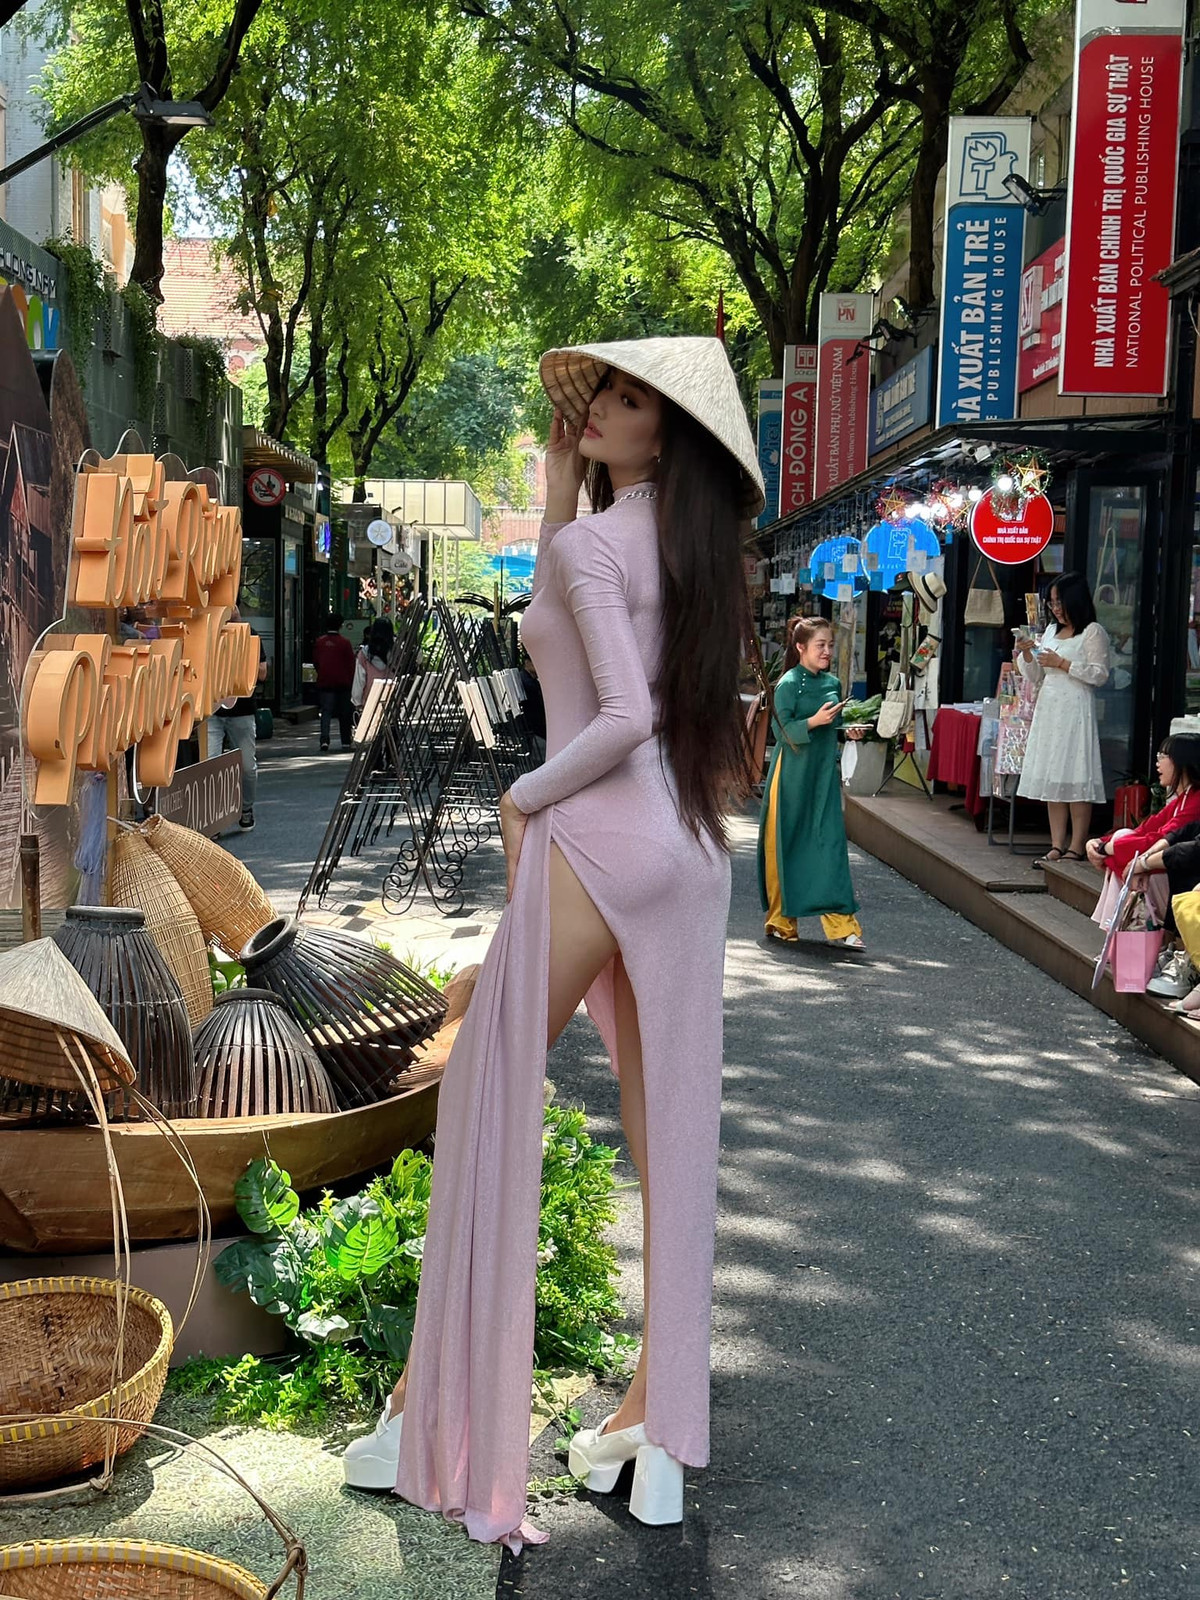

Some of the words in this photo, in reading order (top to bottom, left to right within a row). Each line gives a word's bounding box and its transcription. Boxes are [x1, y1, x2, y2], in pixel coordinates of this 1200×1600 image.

[1105, 54, 1133, 90] THẬT
[1140, 56, 1155, 108] HOUSE
[1106, 92, 1132, 114] SỰ
[1106, 117, 1127, 142] GIA
[1099, 146, 1127, 185] QUỐC
[1135, 114, 1151, 205] PUBLISHING
[1102, 189, 1127, 212] TRỊ
[956, 219, 990, 266] TRẺ
[992, 216, 1007, 276] HOUSE
[1097, 215, 1122, 259] CHÍNH
[1130, 210, 1147, 286] POLITICAL
[1092, 263, 1119, 294] BẢN
[953, 272, 988, 324] BẢN
[1090, 297, 1117, 334] XUẤT
[986, 288, 1005, 401] PUBLISHING
[1126, 291, 1142, 368] NATIONAL
[832, 347, 843, 371] NAM
[951, 330, 985, 390] XUẤT
[1091, 337, 1115, 368] NHÀ
[791, 387, 809, 403] A
[831, 373, 844, 394] VIỆT
[831, 414, 843, 434] PHỤ
[848, 386, 858, 426] Publishing
[951, 395, 982, 422] HÀ
[785, 408, 808, 476] ĐÔNG
[827, 435, 840, 455] BẢN
[825, 456, 839, 483] XUẤT
[184, 763, 241, 832] 20.10.2023
